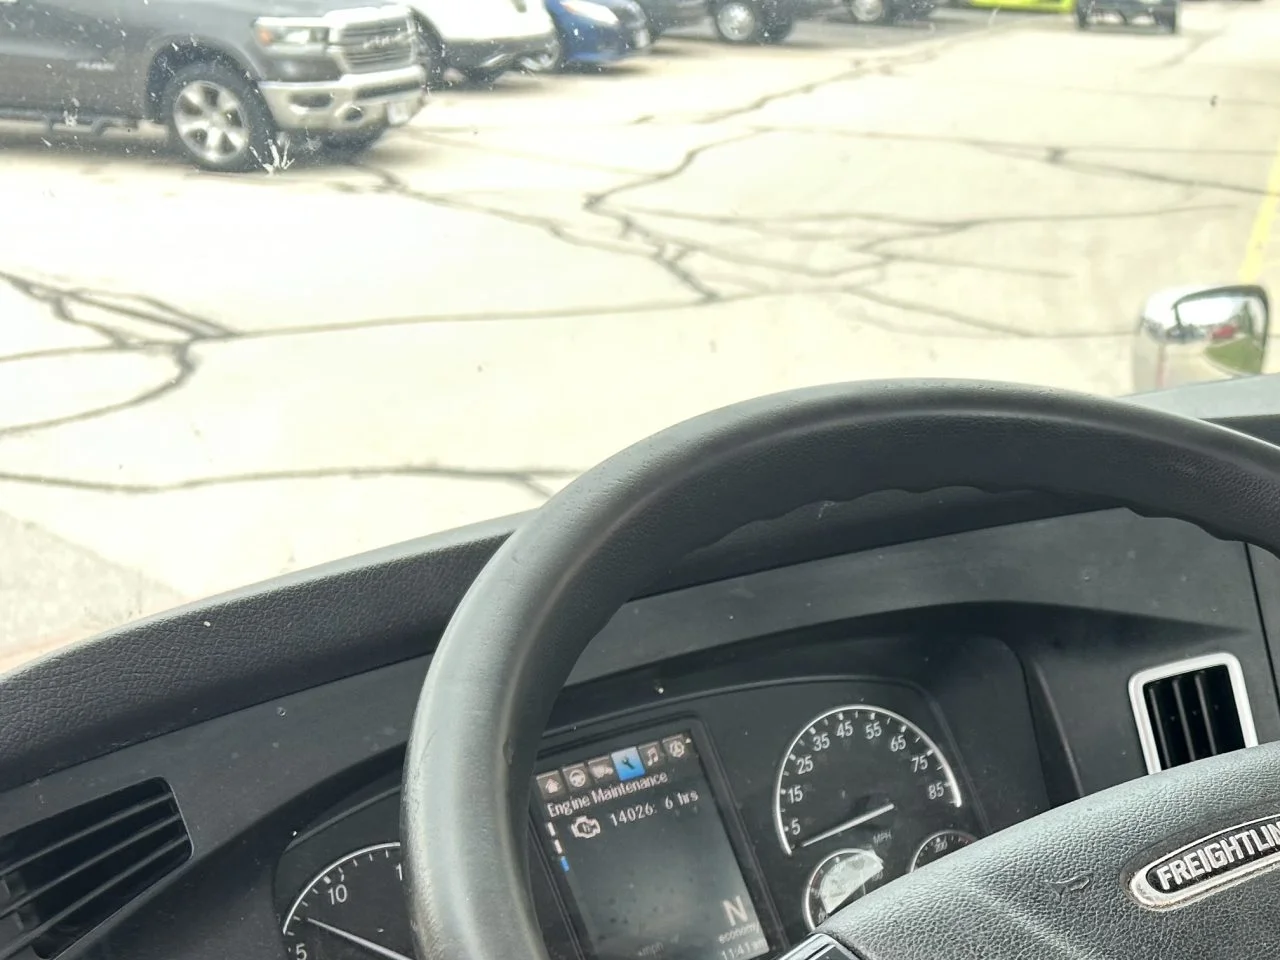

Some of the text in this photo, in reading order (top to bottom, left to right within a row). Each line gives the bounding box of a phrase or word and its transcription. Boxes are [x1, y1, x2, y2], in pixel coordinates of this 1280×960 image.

[836, 721, 853, 737] 45
[865, 723, 882, 739] 55
[813, 734, 831, 751] 35
[890, 735, 906, 752] 65
[797, 756, 813, 774] 25
[911, 755, 928, 773] 75
[546, 771, 668, 818] Engine Maintenance
[665, 796, 674, 810] 6
[676, 790, 699, 806] hrs
[788, 786, 803, 803] 15
[928, 783, 945, 800] 85
[792, 819, 801, 836] 5
[872, 830, 892, 844] MPH
[328, 884, 348, 905] 10
[723, 895, 748, 927] N
